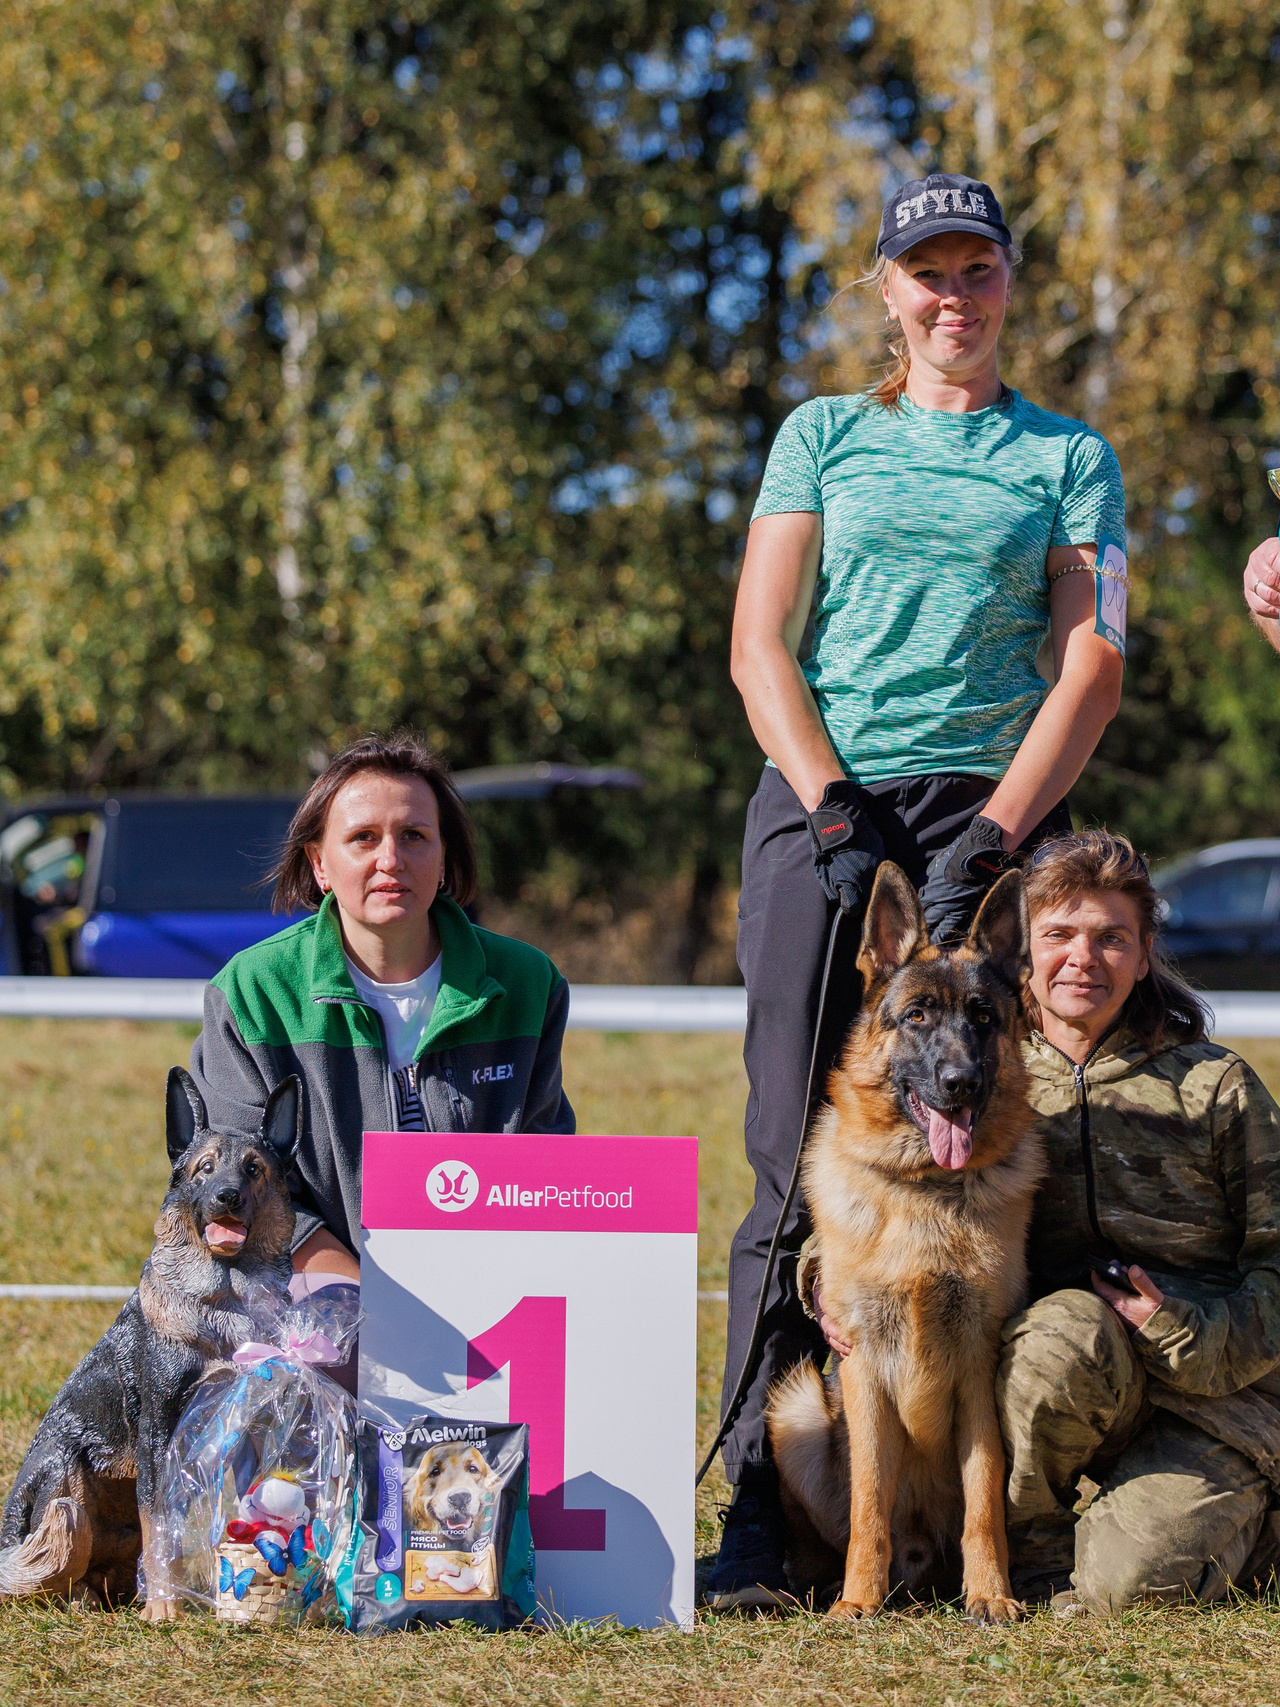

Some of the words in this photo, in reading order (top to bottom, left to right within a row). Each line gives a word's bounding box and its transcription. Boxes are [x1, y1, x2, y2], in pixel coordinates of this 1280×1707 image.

[895, 189, 989, 229] STYLE
[472, 1063, 515, 1085] K-FLEX
[486, 1184, 633, 1209] AllerPetfood
[411, 1424, 487, 1444] Melwin
[467, 1296, 606, 1551] 1
[464, 1439, 488, 1449] dogs
[381, 1465, 399, 1531] SENIOR
[384, 1580, 393, 1591] 1
